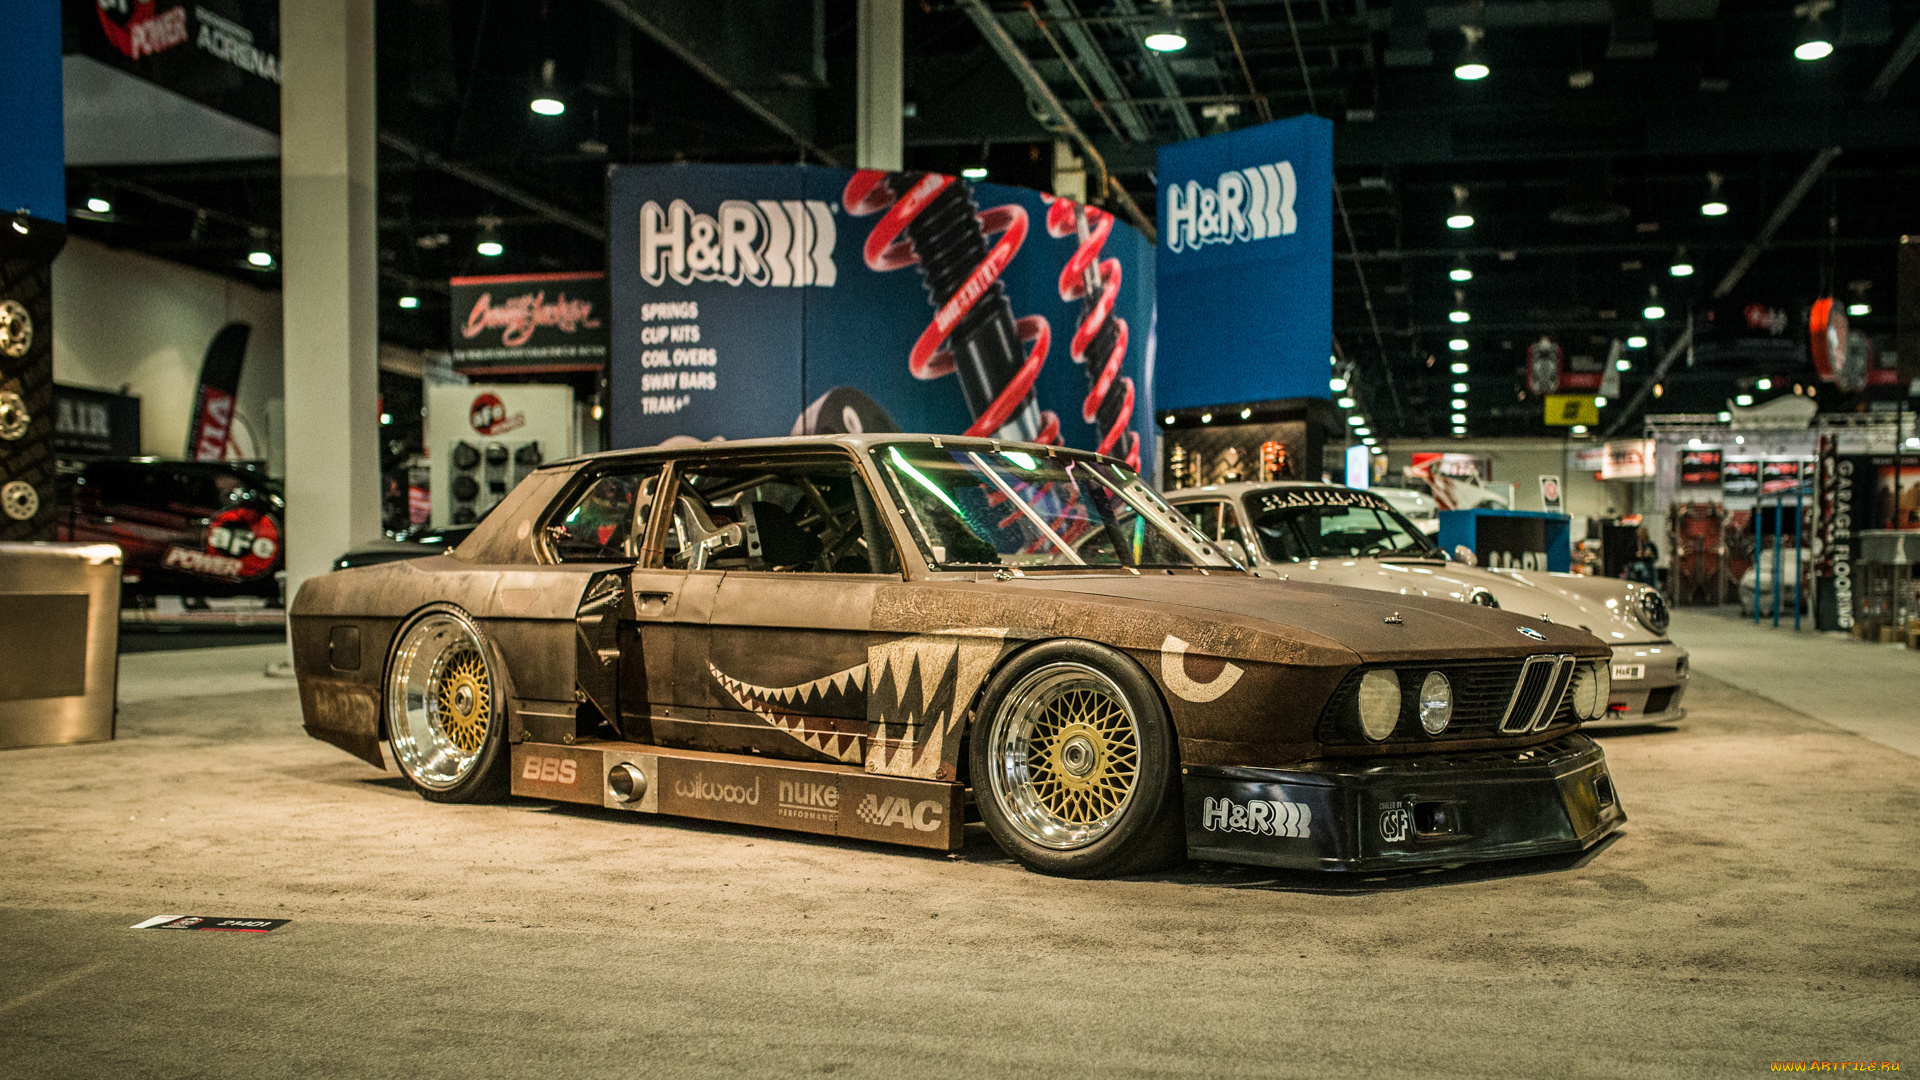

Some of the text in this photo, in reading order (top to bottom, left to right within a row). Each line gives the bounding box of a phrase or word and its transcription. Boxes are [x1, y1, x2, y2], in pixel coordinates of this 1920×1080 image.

[1167, 170, 1251, 253] H&R
[640, 199, 771, 287] H&R
[641, 301, 698, 321] SPRINGS
[641, 324, 700, 345] CUP KITS
[641, 348, 717, 368] COIL OVERS
[641, 371, 717, 391] SWAY BARS
[1835, 460, 1854, 539] GARAGE
[1833, 545, 1855, 629] FLOORING
[522, 755, 577, 784] BBS
[674, 773, 759, 806] wilwood
[779, 780, 840, 808] nuke
[857, 793, 944, 833] VAC
[1203, 796, 1275, 837] H&R
[1379, 809, 1408, 842] CSF
